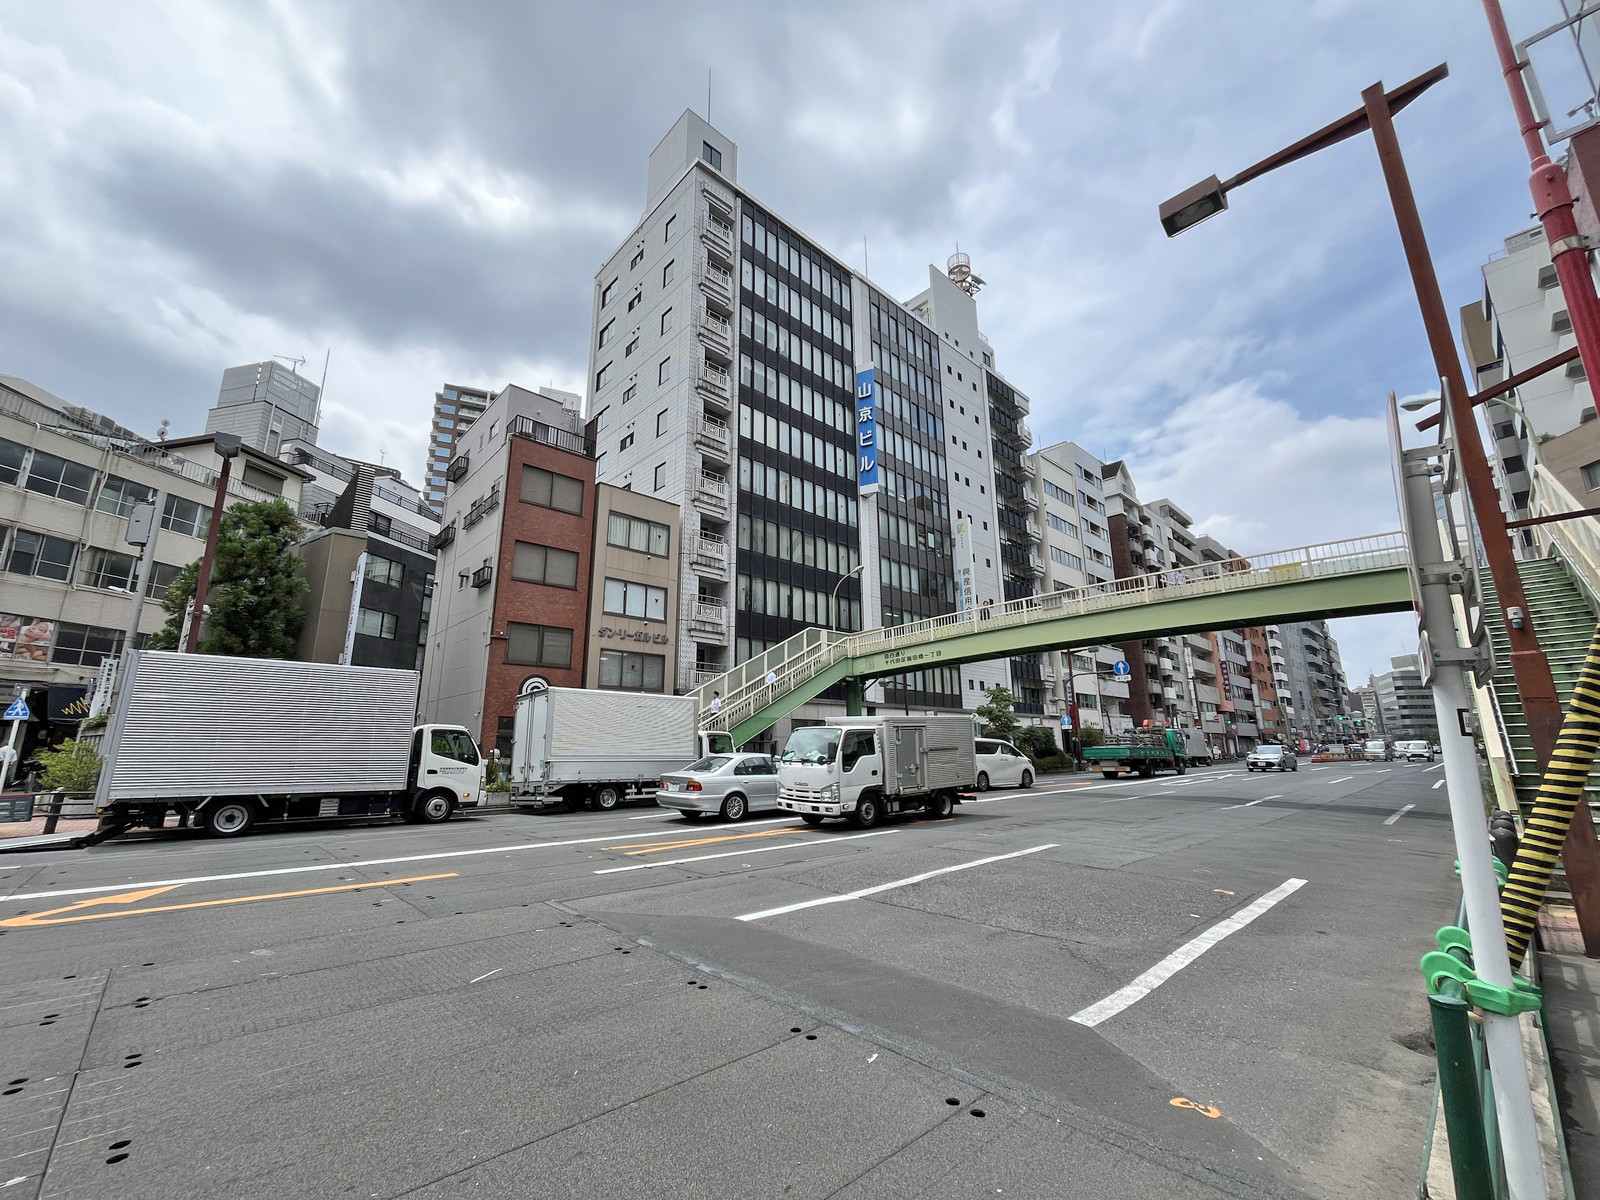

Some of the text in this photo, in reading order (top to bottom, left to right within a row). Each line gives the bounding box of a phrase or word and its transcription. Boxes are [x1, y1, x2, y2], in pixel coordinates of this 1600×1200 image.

[858, 381, 875, 473] 山京ビル
[885, 650, 942, 665] 千代田区飯田橋一丁目
